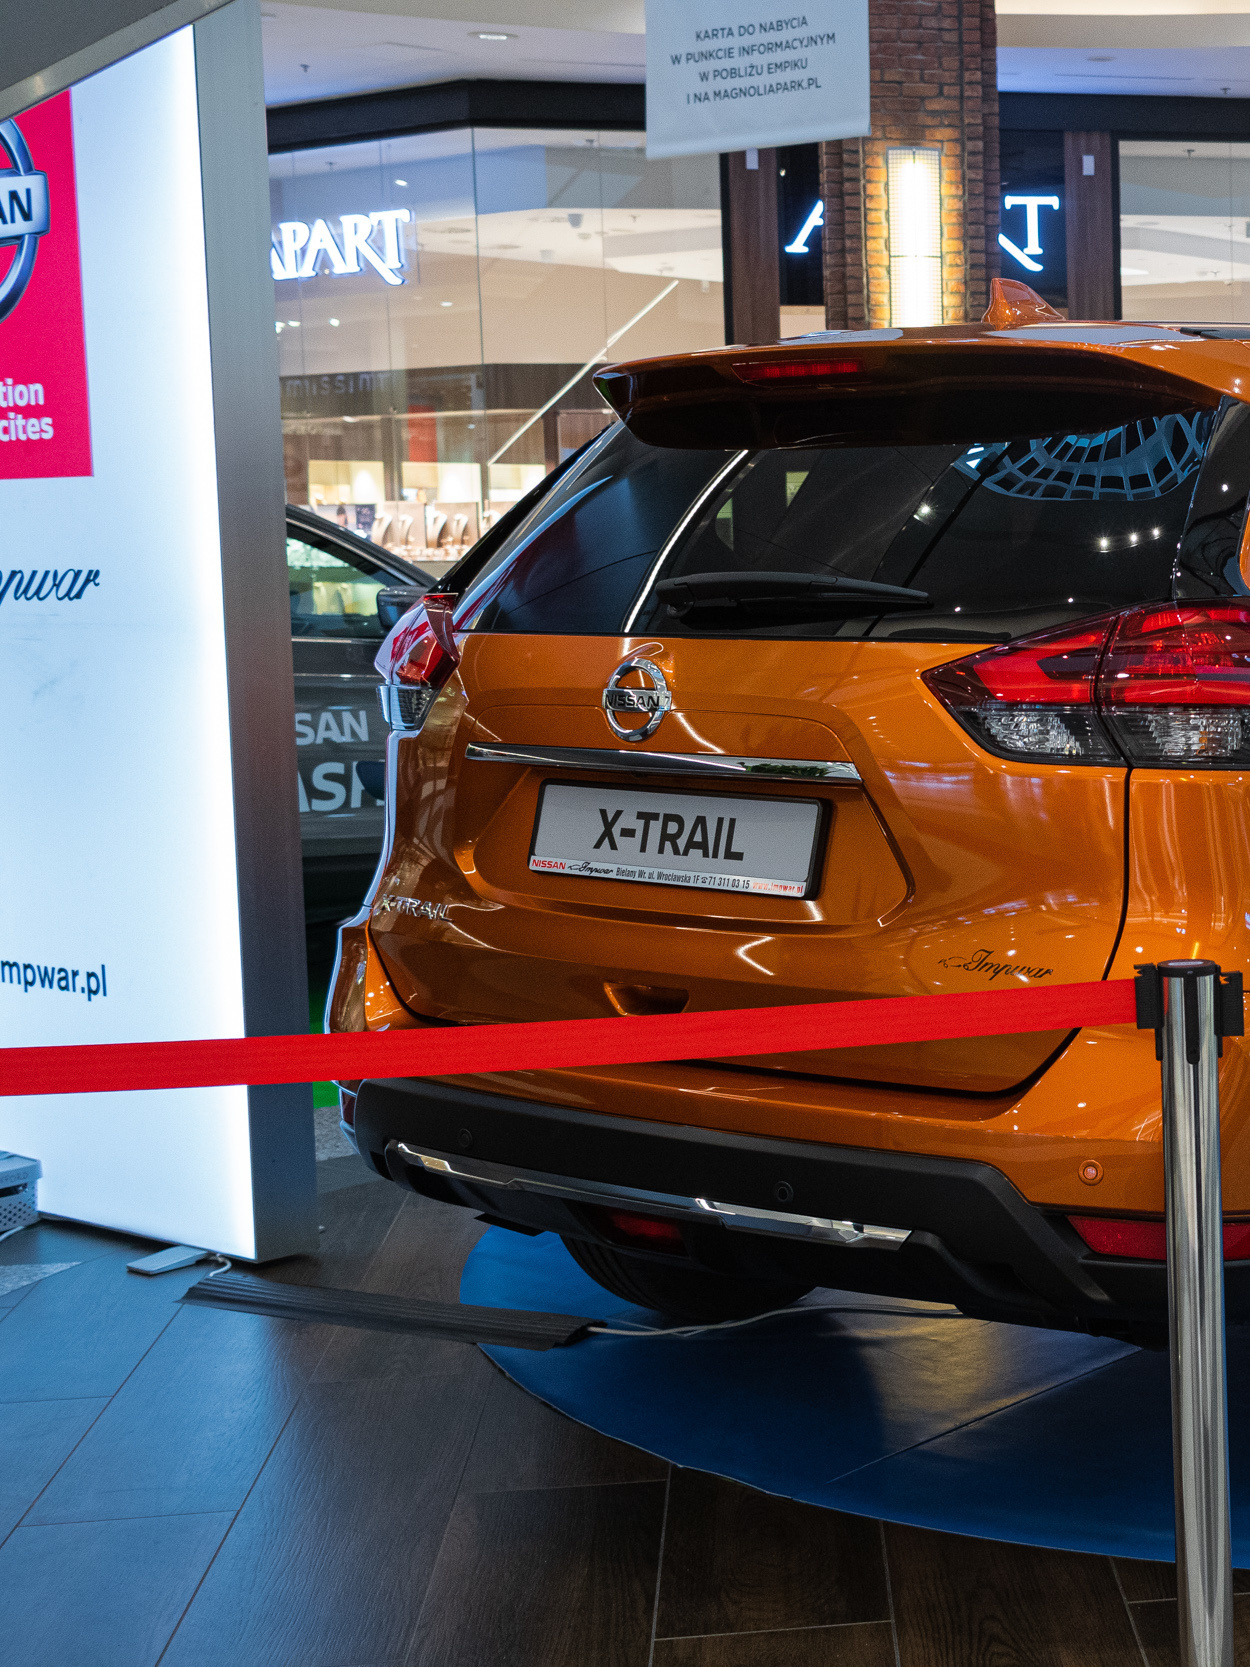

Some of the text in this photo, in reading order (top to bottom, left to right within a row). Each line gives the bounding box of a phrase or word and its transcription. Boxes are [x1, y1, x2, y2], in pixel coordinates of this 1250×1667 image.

[696, 16, 808, 42] KARTA DO NABYCIA
[671, 33, 836, 66] W PUNKCIE INFORMACYJNYM
[699, 58, 808, 82] W POBLIŻU EMPIKU
[686, 77, 822, 104] I NA MAGNOLIAPARK.PL
[605, 694, 660, 708] NISSAN
[295, 710, 369, 746] SAN
[593, 808, 745, 861] X-TRAIL
[531, 859, 567, 870] NISSAN
[616, 867, 637, 879] Bielany
[693, 874, 700, 884] 1F
[708, 876, 716, 886] 71
[718, 877, 730, 888] 311
[731, 878, 740, 889] 03
[742, 880, 751, 890] 15
[381, 893, 453, 921] X-TRAIL
[963, 949, 1054, 981] Impwar
[0, 960, 107, 1002] mpwar.pl
